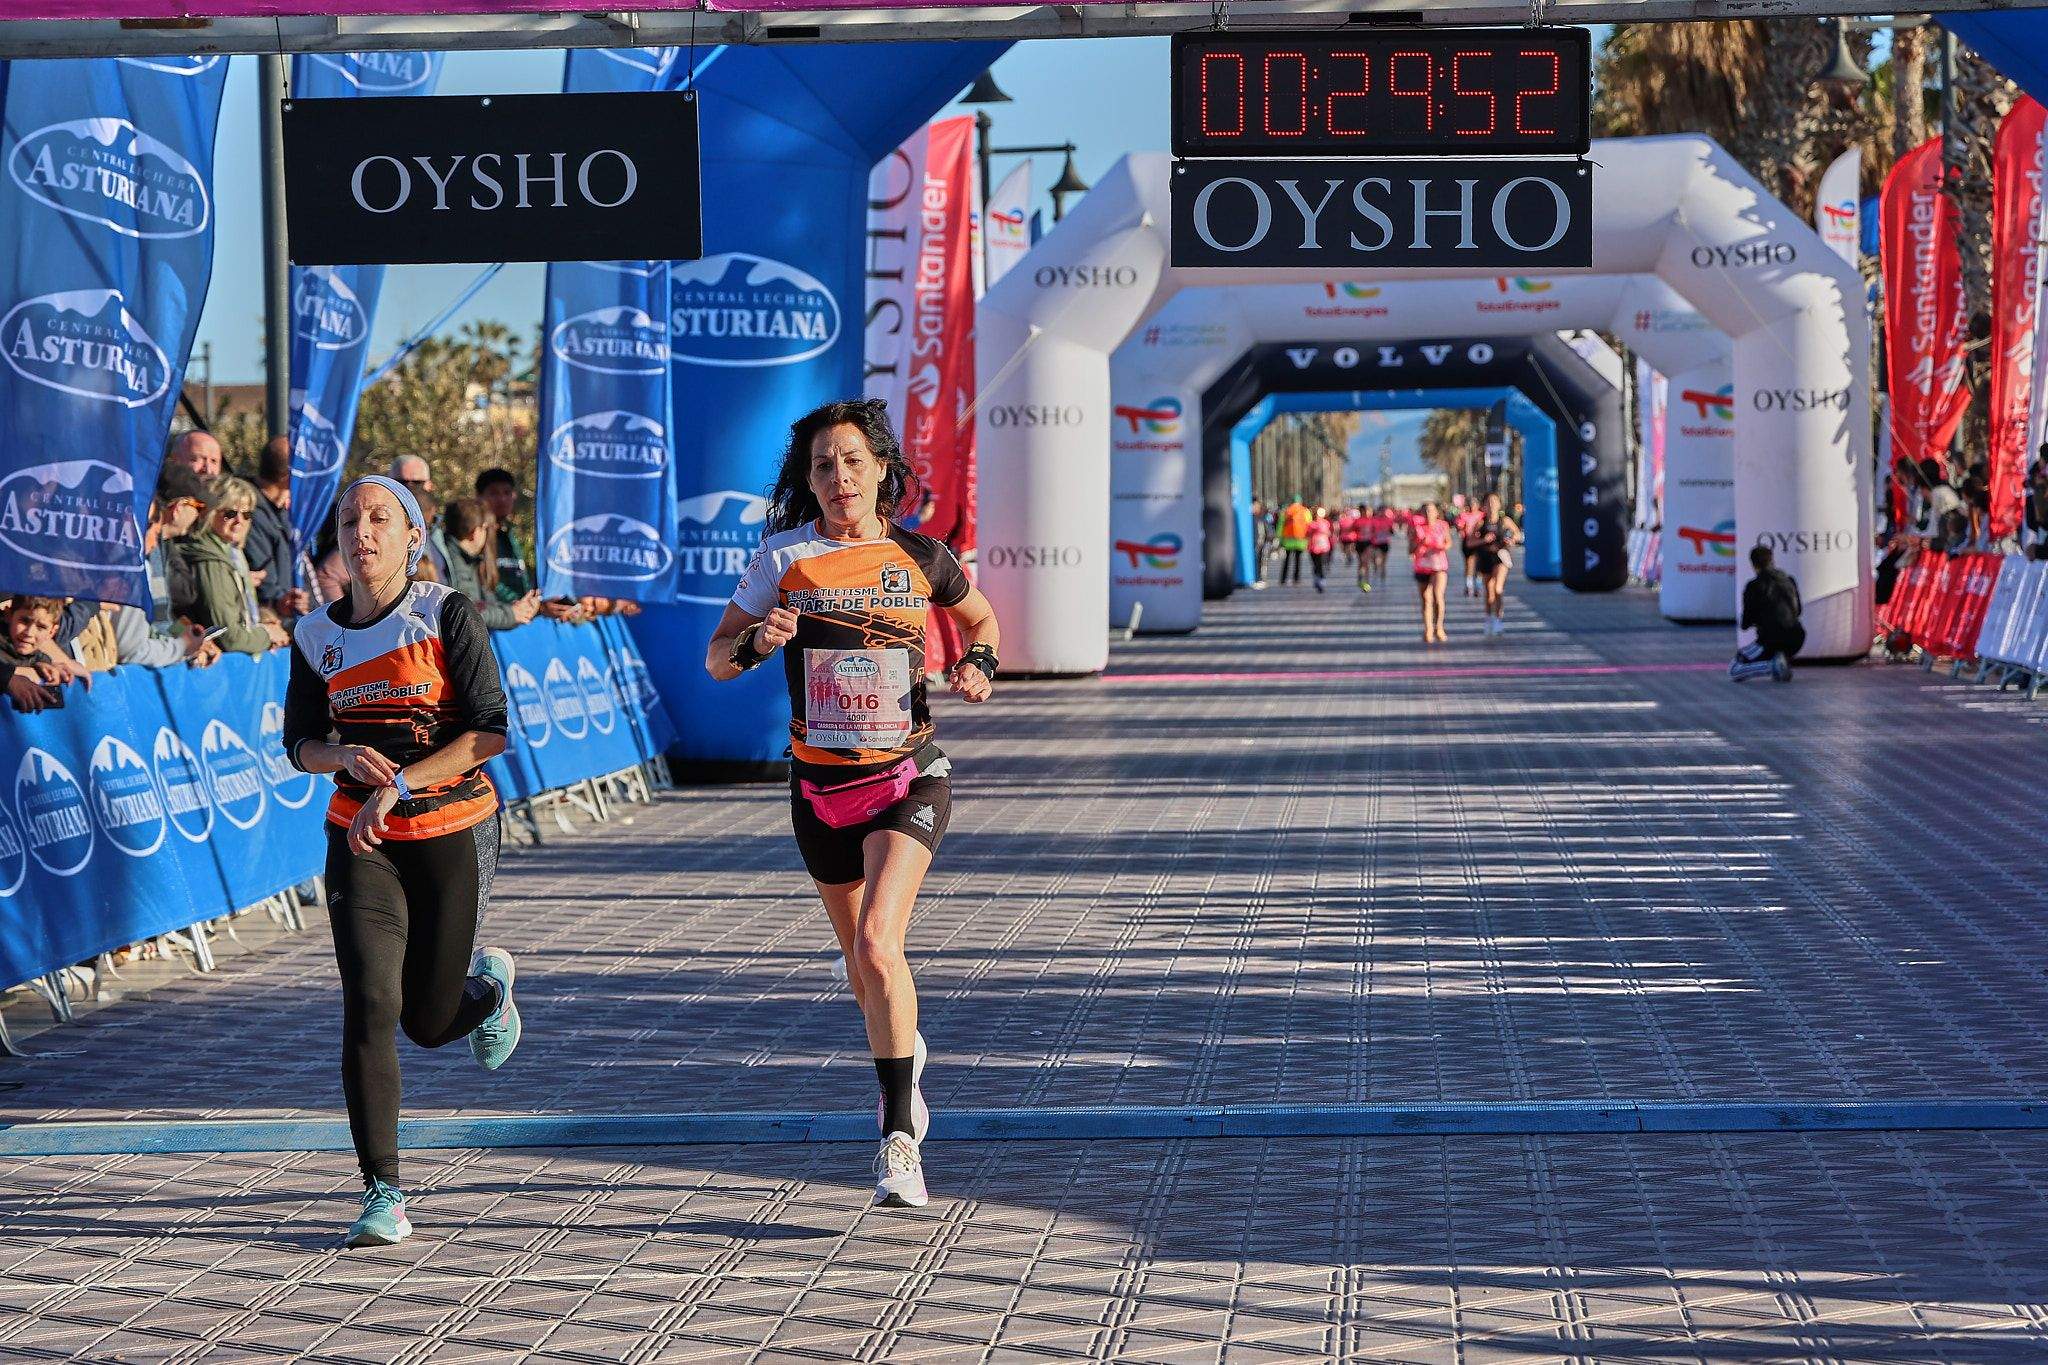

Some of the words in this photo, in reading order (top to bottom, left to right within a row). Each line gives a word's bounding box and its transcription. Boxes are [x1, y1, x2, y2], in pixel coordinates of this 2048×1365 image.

[1202, 52, 1560, 137] 00:29:52
[25, 143, 195, 227] ASTURIANA
[350, 149, 638, 213] OYSHO
[1193, 176, 1571, 252] OYSHO
[912, 171, 948, 358] Santander
[1691, 242, 1797, 269] OYSHO
[1034, 265, 1138, 289] OYSHO
[1907, 190, 1936, 355] Santander
[1305, 306, 1389, 318] TotalEnergies
[1476, 299, 1561, 314] TotalEnergies
[671, 307, 829, 341] STURIANA
[1286, 342, 1494, 370] VOLVO
[1753, 388, 1851, 413] OYSHO
[988, 404, 1084, 429] OYSHO
[1579, 420, 1600, 572] VOLVO
[1756, 530, 1853, 554] OYSHO
[987, 545, 1082, 570] OYSHO
[811, 587, 878, 600] ATLETISME
[840, 597, 864, 611] DE
[869, 595, 927, 609] POBLET
[837, 664, 877, 674] ASTURIANA
[342, 680, 390, 698] ATLETISME
[364, 690, 381, 703] DE
[380, 681, 433, 700] POBLET
[838, 693, 880, 710] 016
[815, 733, 848, 742] OYSHO
[816, 722, 838, 730] CARRERA
